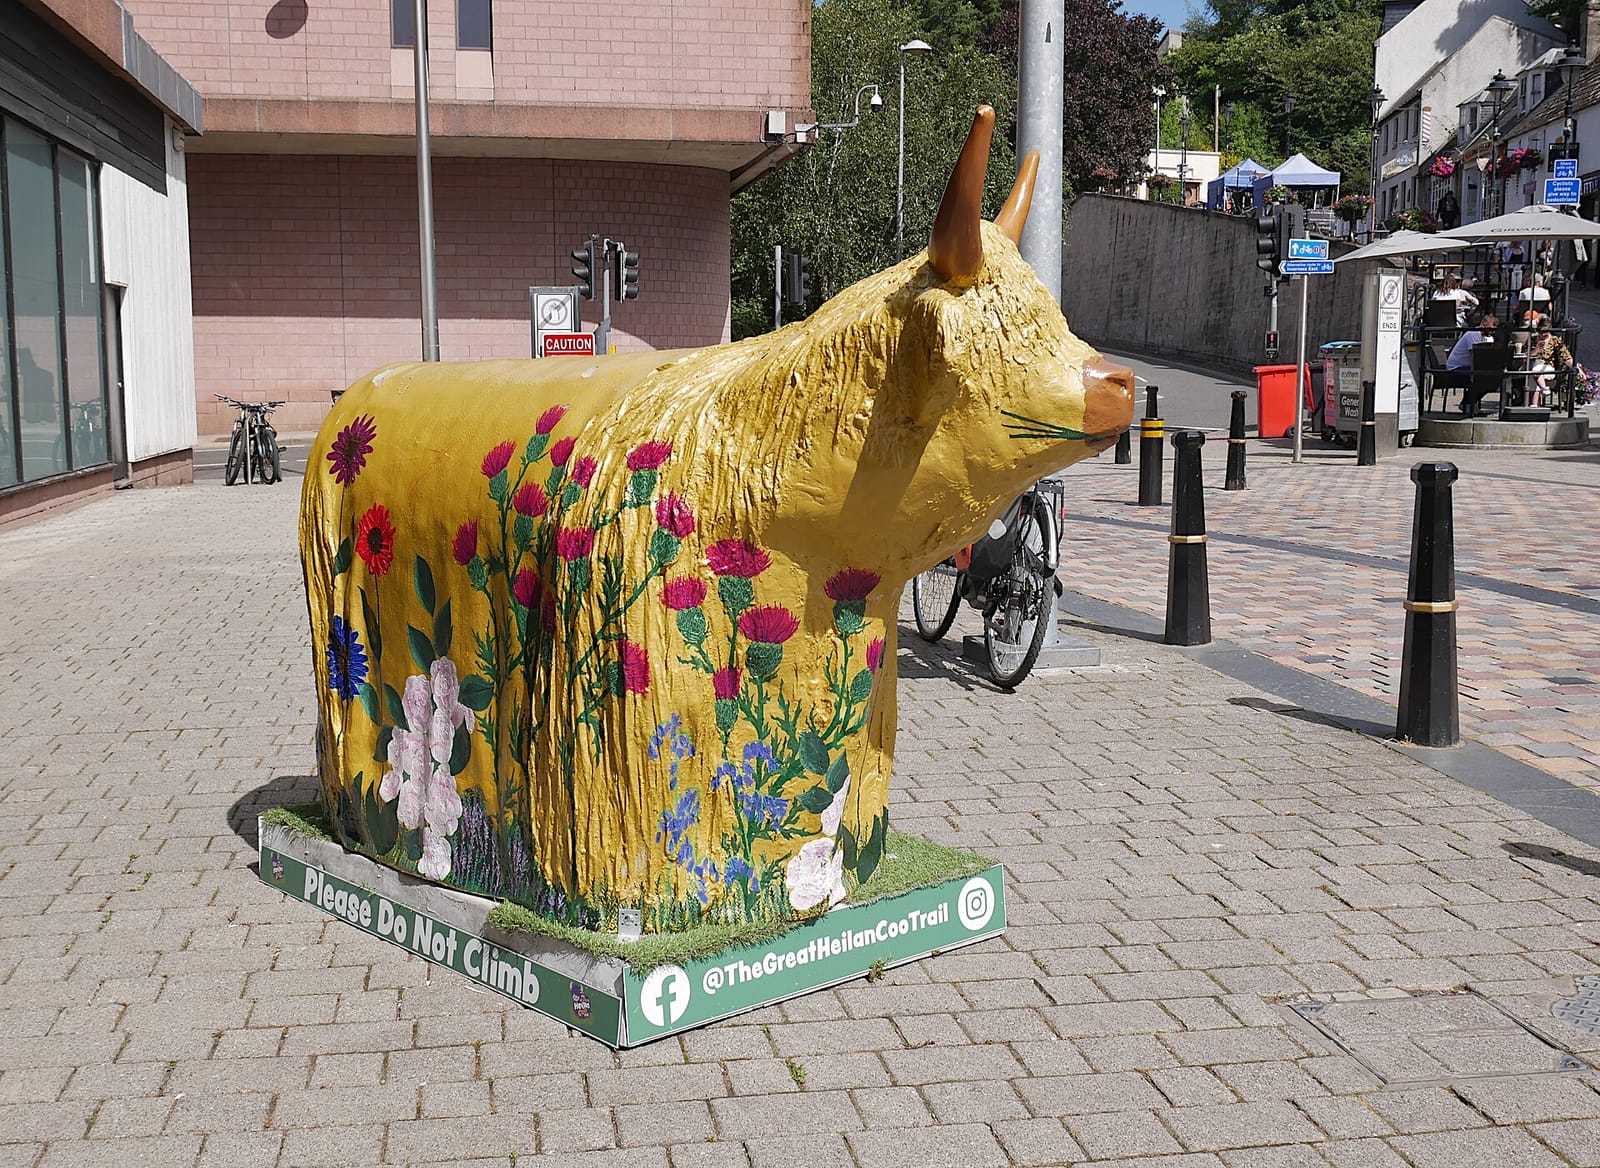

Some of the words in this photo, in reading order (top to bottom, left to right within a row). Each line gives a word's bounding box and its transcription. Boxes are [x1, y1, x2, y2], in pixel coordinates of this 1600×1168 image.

[545, 338, 592, 350] CAUTION
[1341, 396, 1360, 407] Gener
[304, 867, 372, 923] Please
[378, 902, 407, 943] Do
[412, 914, 457, 967] Not
[463, 938, 540, 1004] Climb
[702, 902, 949, 995] @TheGreatHeilanCooTrail
